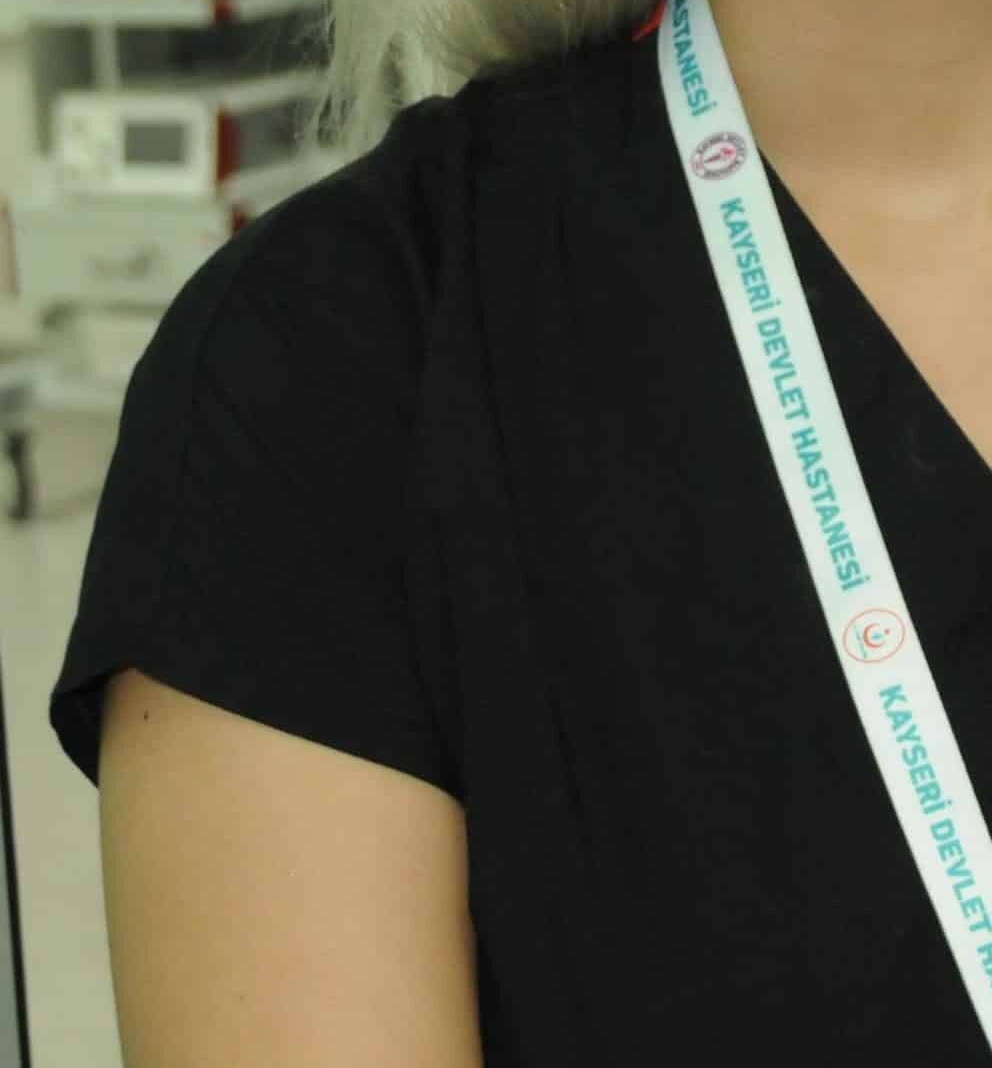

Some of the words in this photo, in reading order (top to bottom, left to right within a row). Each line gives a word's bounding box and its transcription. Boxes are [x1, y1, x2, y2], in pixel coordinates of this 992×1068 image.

[719, 195, 783, 314] KAYSERİ
[755, 316, 813, 422] DEVLET
[790, 425, 871, 593] HASTANESİ
[878, 684, 953, 817] KAYSERİ
